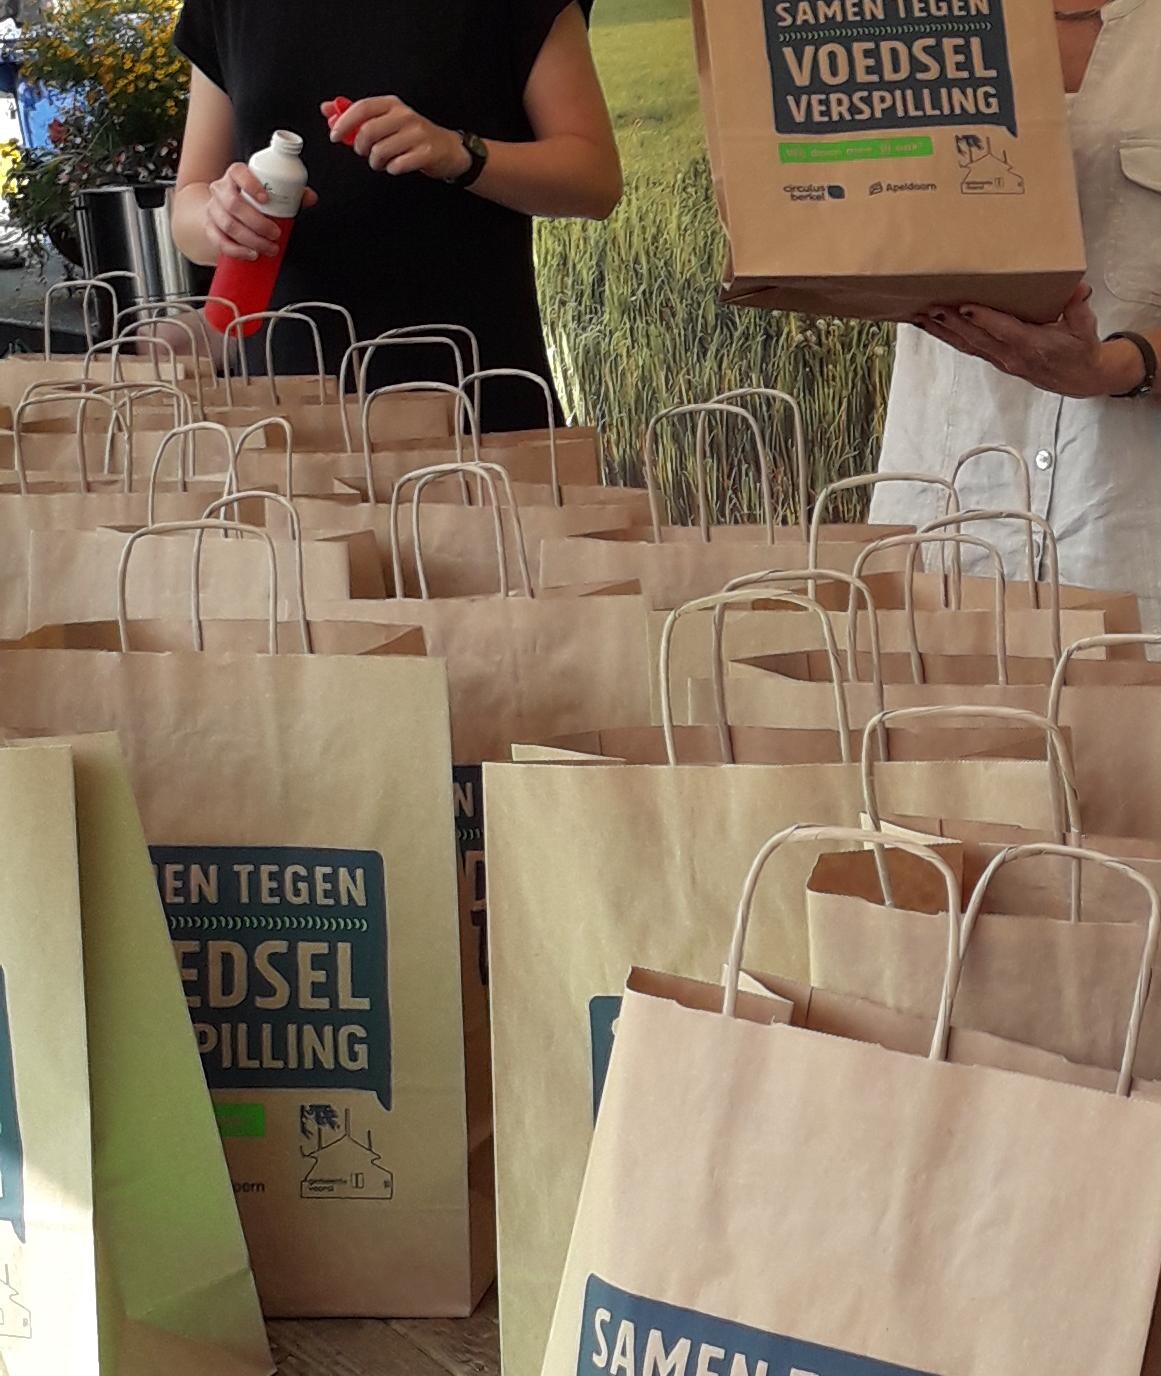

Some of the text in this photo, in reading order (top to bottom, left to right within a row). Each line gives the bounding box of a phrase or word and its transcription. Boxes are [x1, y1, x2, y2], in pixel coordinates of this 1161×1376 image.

[782, 36, 997, 87] VOEDSEL
[786, 85, 999, 123] VERSPILLING
[886, 181, 937, 193] Apeldoorn
[233, 864, 367, 907] TEGEN
[175, 940, 371, 1010] EDSEL
[197, 1022, 369, 1071] PILLING
